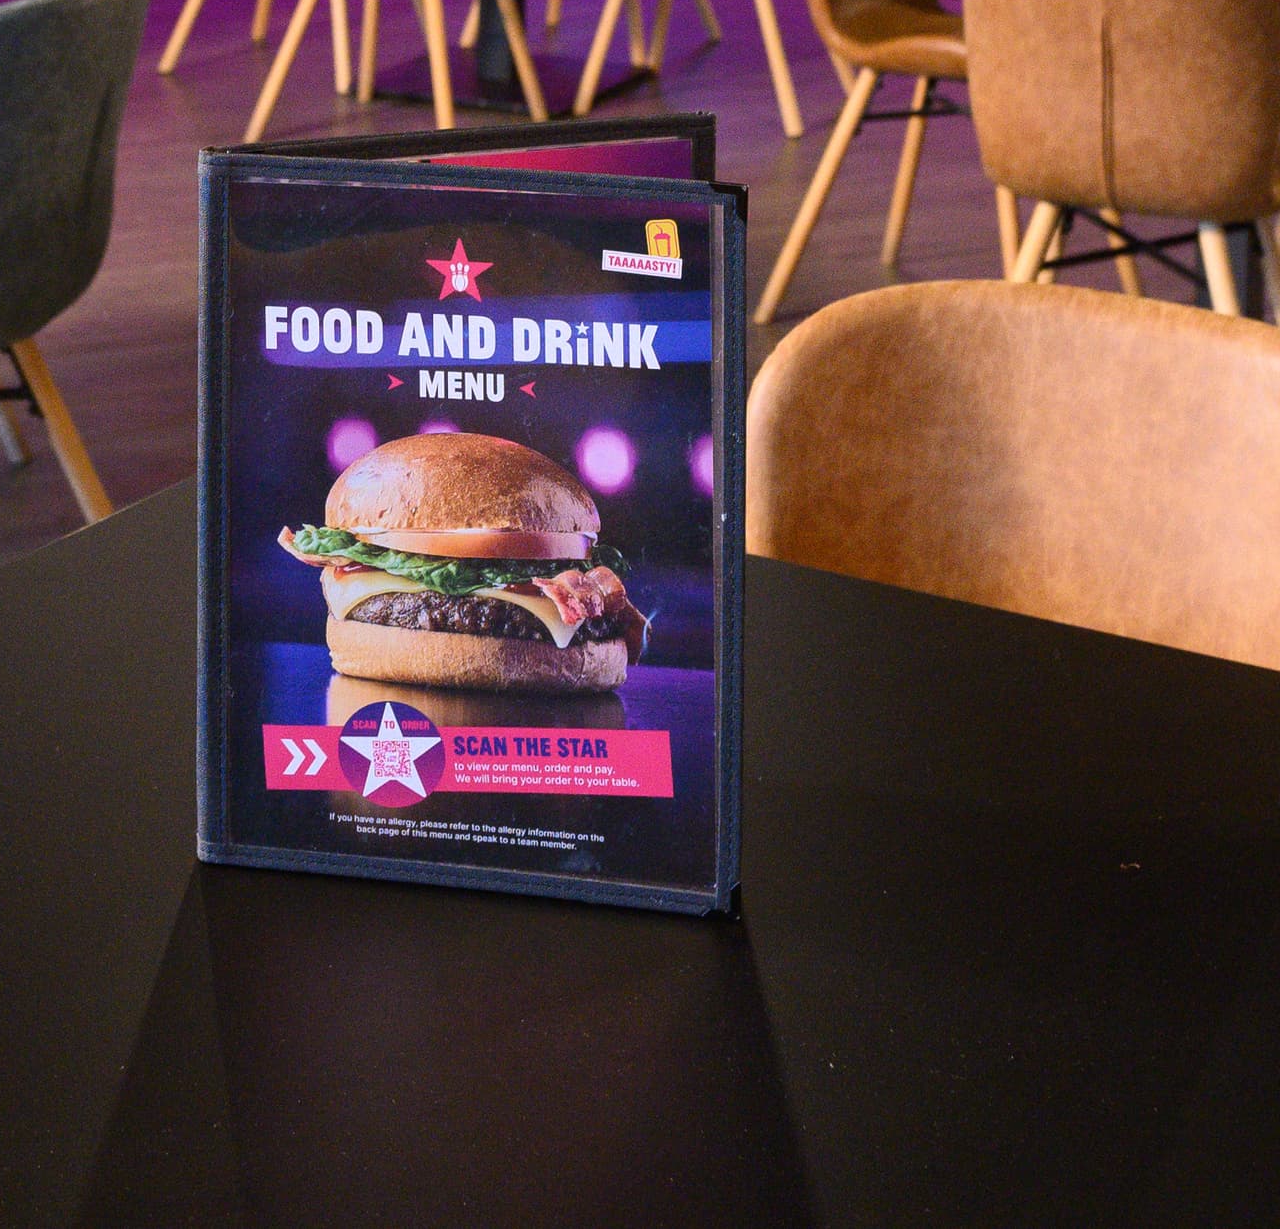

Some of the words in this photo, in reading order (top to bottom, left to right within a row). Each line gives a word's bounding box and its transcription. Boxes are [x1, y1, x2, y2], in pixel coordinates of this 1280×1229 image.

[265, 305, 384, 355] FOOD
[398, 312, 497, 361] AND
[419, 370, 505, 403] MENU
[384, 720, 395, 730] TO
[453, 736, 507, 757] SCAN
[513, 737, 551, 757] THE
[557, 737, 608, 759] STAR
[454, 762, 464, 771] to
[466, 761, 490, 771] view
[492, 763, 509, 771] our
[511, 763, 542, 774] menu,
[544, 763, 571, 773] order
[573, 764, 592, 774] and
[594, 765, 616, 776] pay.
[454, 773, 471, 783] We
[473, 773, 490, 783] will
[492, 774, 518, 786] bring
[520, 776, 542, 787] your
[544, 775, 572, 785] order
[574, 776, 585, 786] to
[586, 777, 609, 788] your
[611, 777, 640, 788] table.
[329, 812, 335, 821] If
[337, 814, 353, 823] you
[354, 814, 375, 824] have
[376, 816, 387, 825] an
[388, 817, 418, 828] allergy,
[420, 819, 448, 829] please
[449, 821, 470, 831] refer
[471, 823, 480, 832] to
[482, 823, 496, 833] the
[497, 825, 526, 837] allergy
[527, 827, 576, 840] information
[577, 833, 589, 842] on
[590, 833, 605, 843] the
[356, 824, 376, 834] back
[378, 827, 399, 837] page
[401, 827, 410, 836] of
[411, 828, 428, 838] this
[429, 830, 453, 840] menu
[454, 831, 471, 841] and
[472, 833, 498, 843] speak
[499, 835, 508, 844] to
[509, 837, 516, 845] a
[517, 836, 539, 847] team
[540, 838, 577, 850] member.
